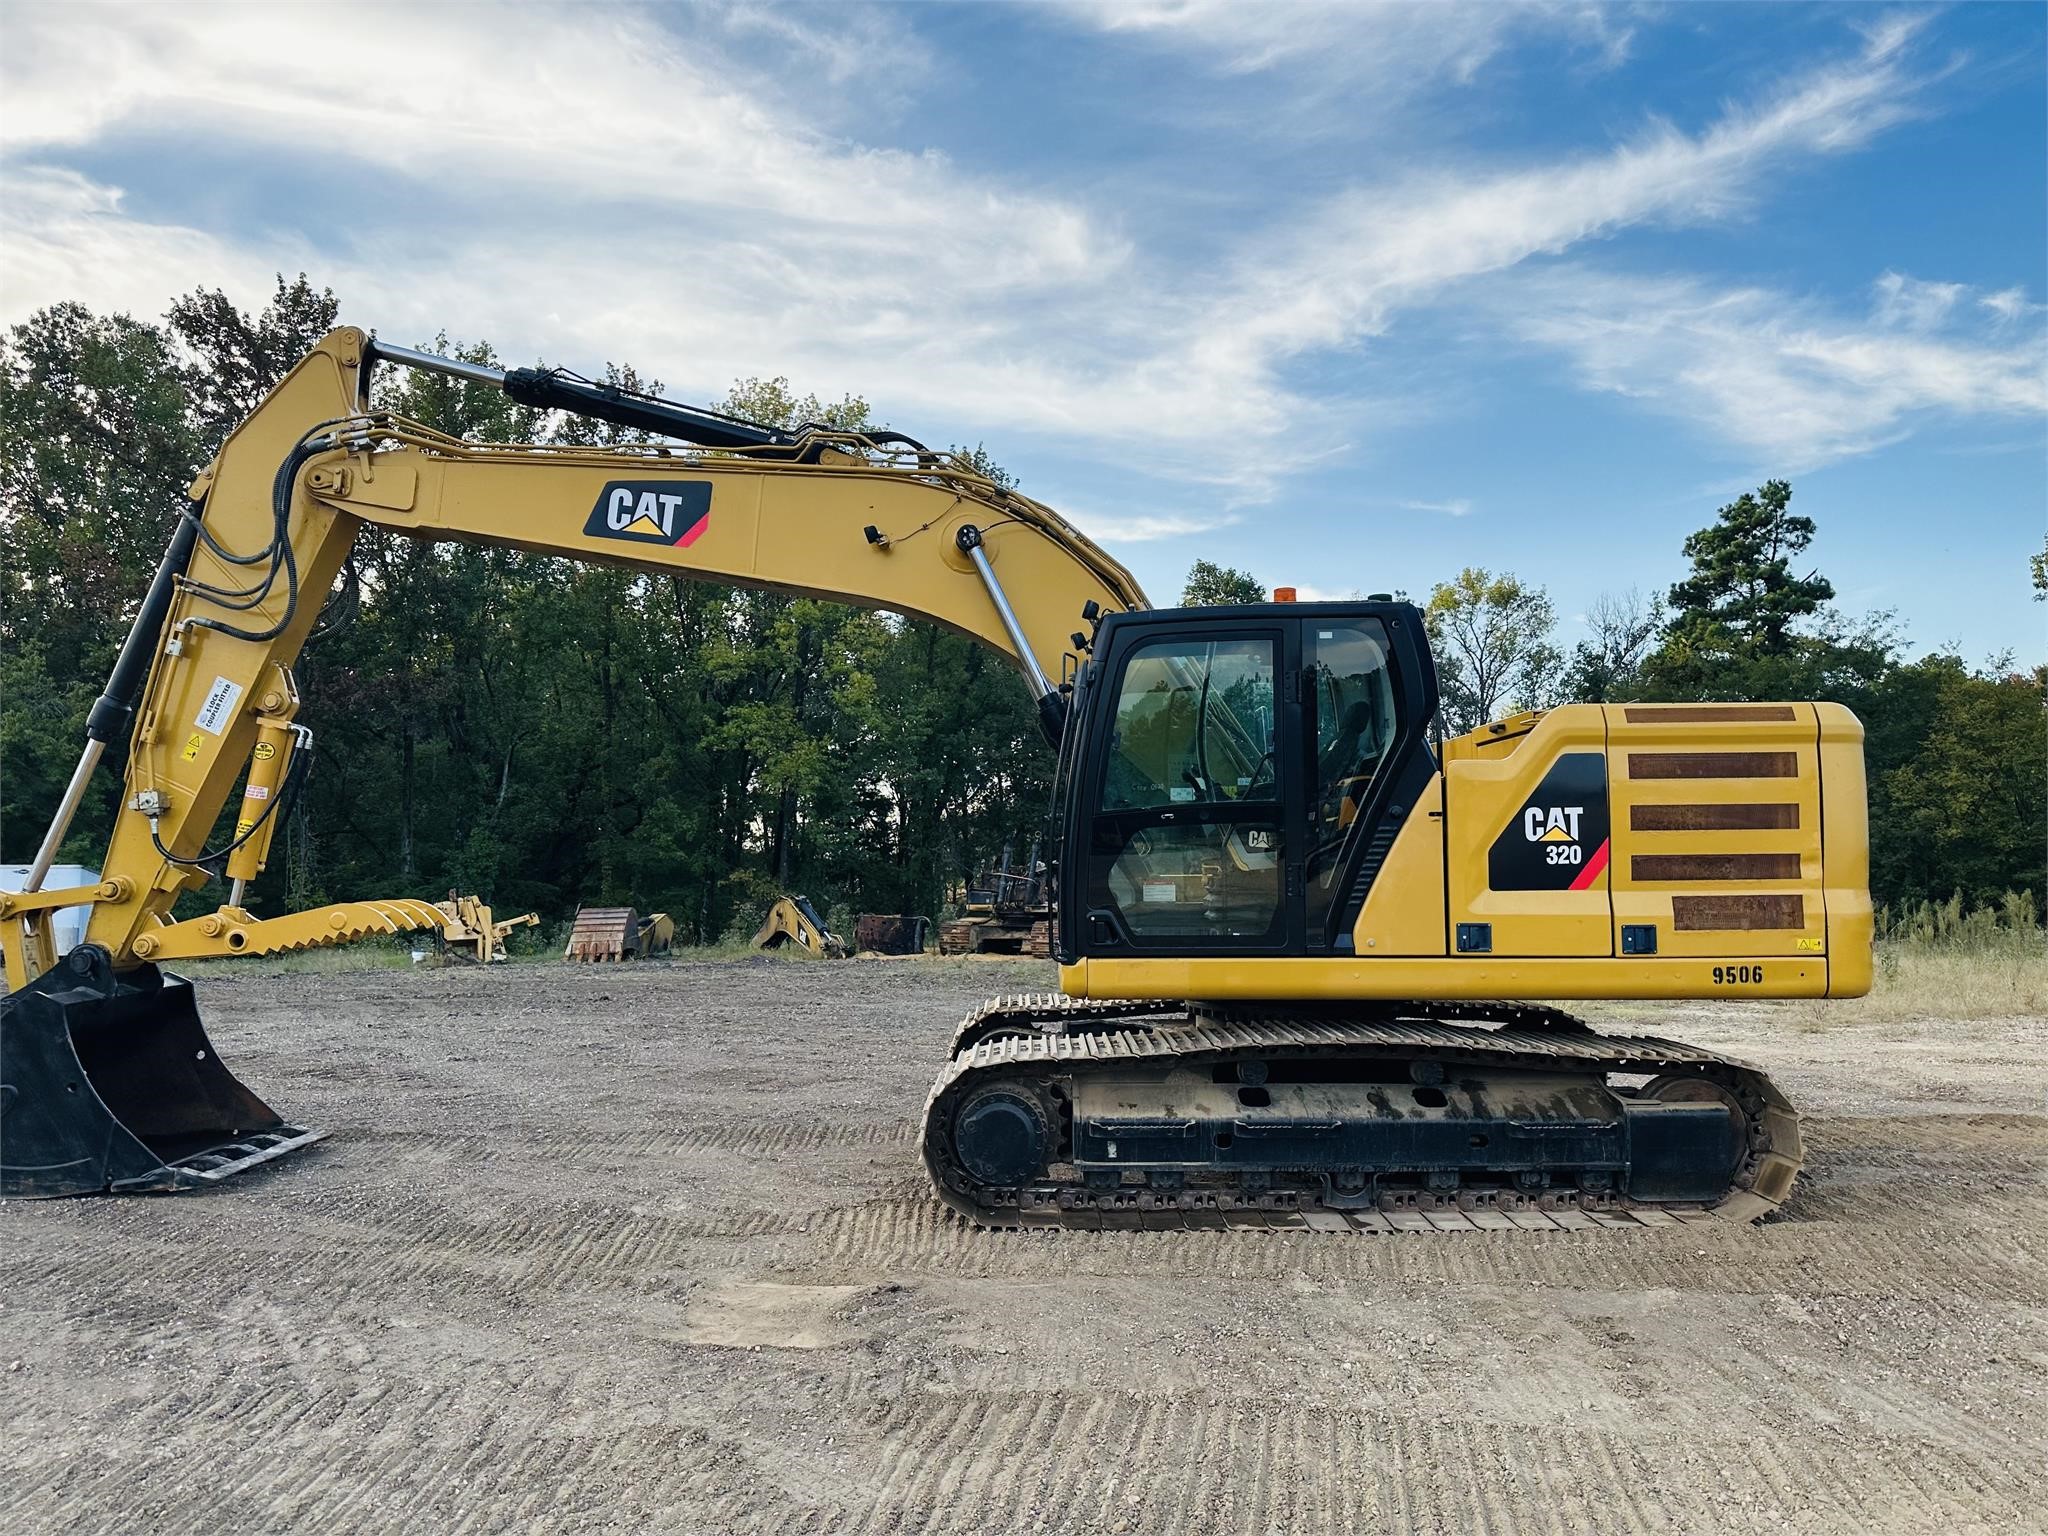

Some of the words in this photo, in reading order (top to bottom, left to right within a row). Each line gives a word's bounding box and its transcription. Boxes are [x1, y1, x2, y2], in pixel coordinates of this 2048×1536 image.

[606, 487, 683, 537] CAT
[205, 703, 221, 728] COUPLER
[218, 683, 231, 703] FITTED
[208, 693, 220, 709] LOCK
[1524, 806, 1584, 842] CAT
[1546, 845, 1582, 865] 320
[1712, 965, 1763, 985] 9506
